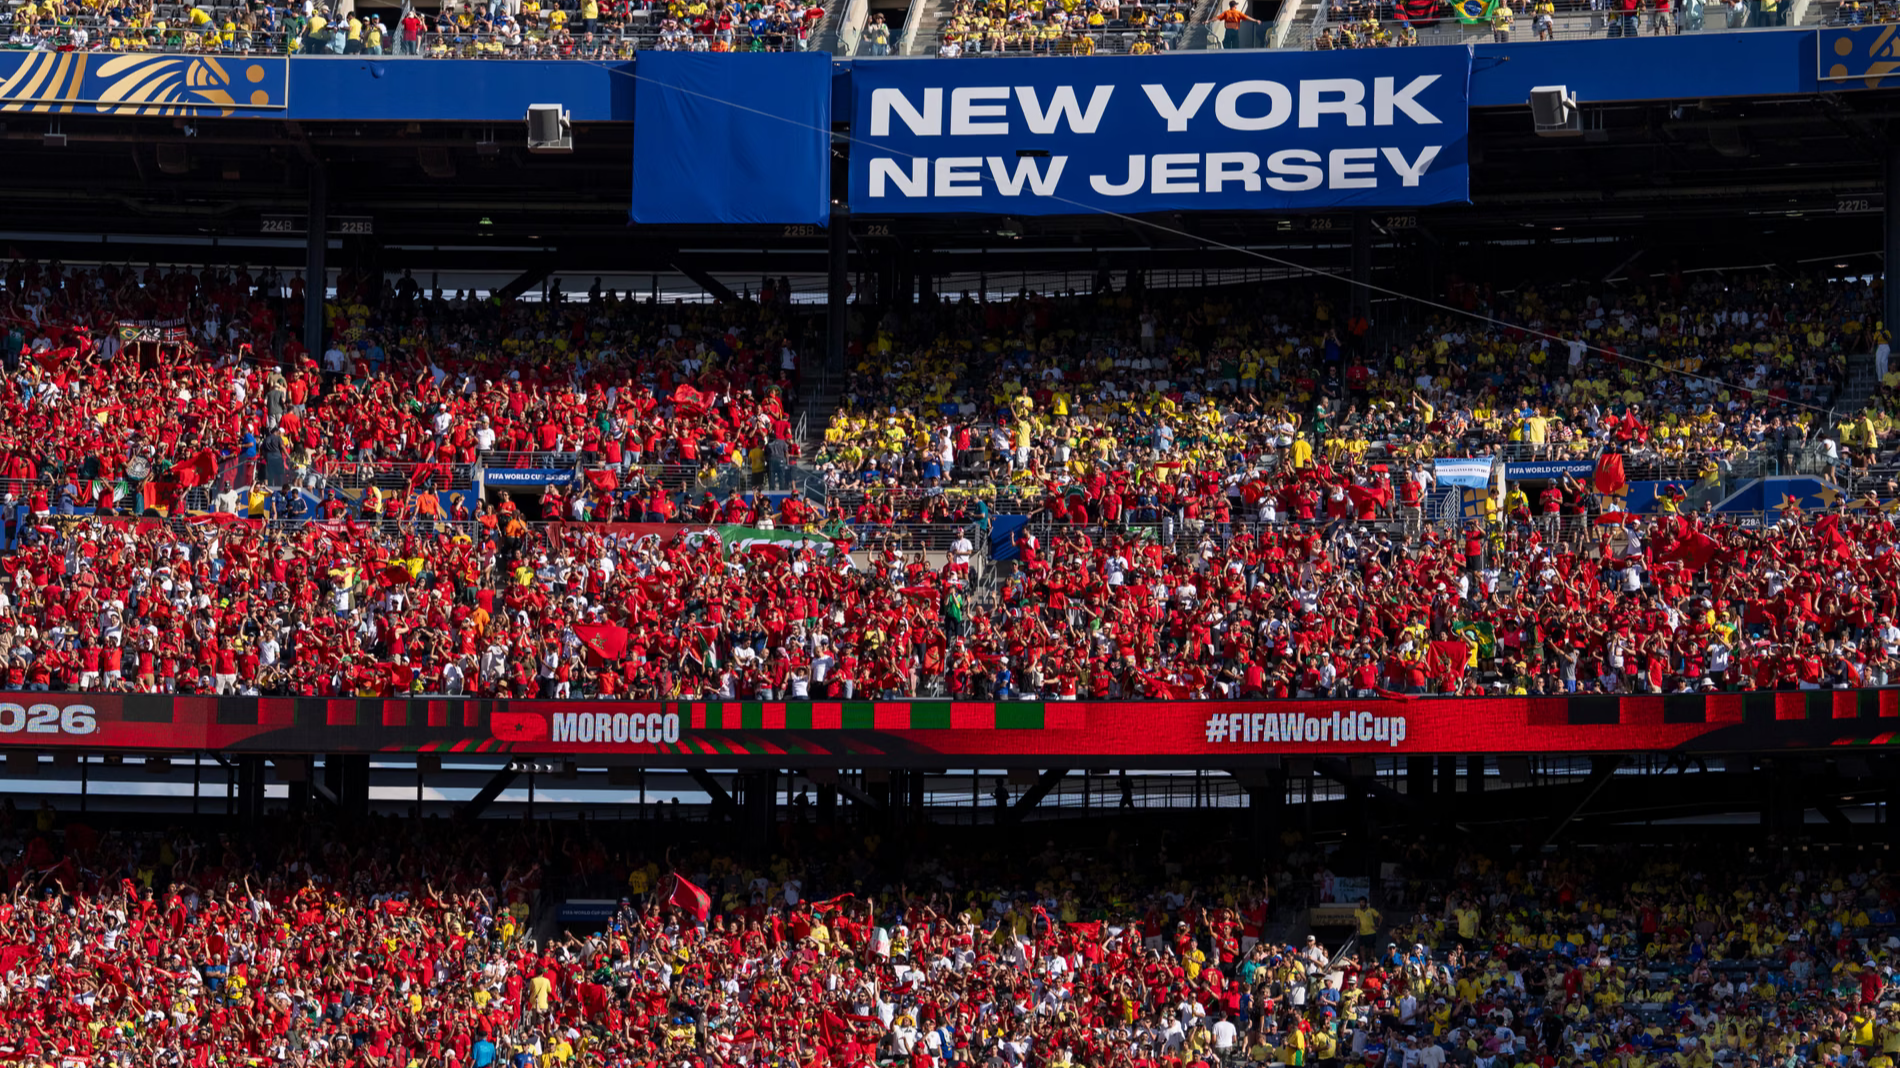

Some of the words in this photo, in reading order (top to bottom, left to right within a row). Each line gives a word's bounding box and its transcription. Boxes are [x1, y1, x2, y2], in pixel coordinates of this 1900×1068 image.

[871, 84, 1114, 136] NEW
[1141, 75, 1443, 132] YORK
[869, 155, 1068, 198] NEW
[1090, 145, 1442, 197] JERSEY
[1838, 200, 1868, 211] 227B
[262, 220, 292, 231] 224B
[342, 222, 372, 232] 225B
[1387, 216, 1416, 227] 227B
[784, 225, 814, 235] 225B
[868, 225, 888, 235] 226
[0, 702, 96, 735] 026
[552, 712, 679, 743] MOROCCO
[1206, 711, 1406, 747] #FIFAWorldCup
